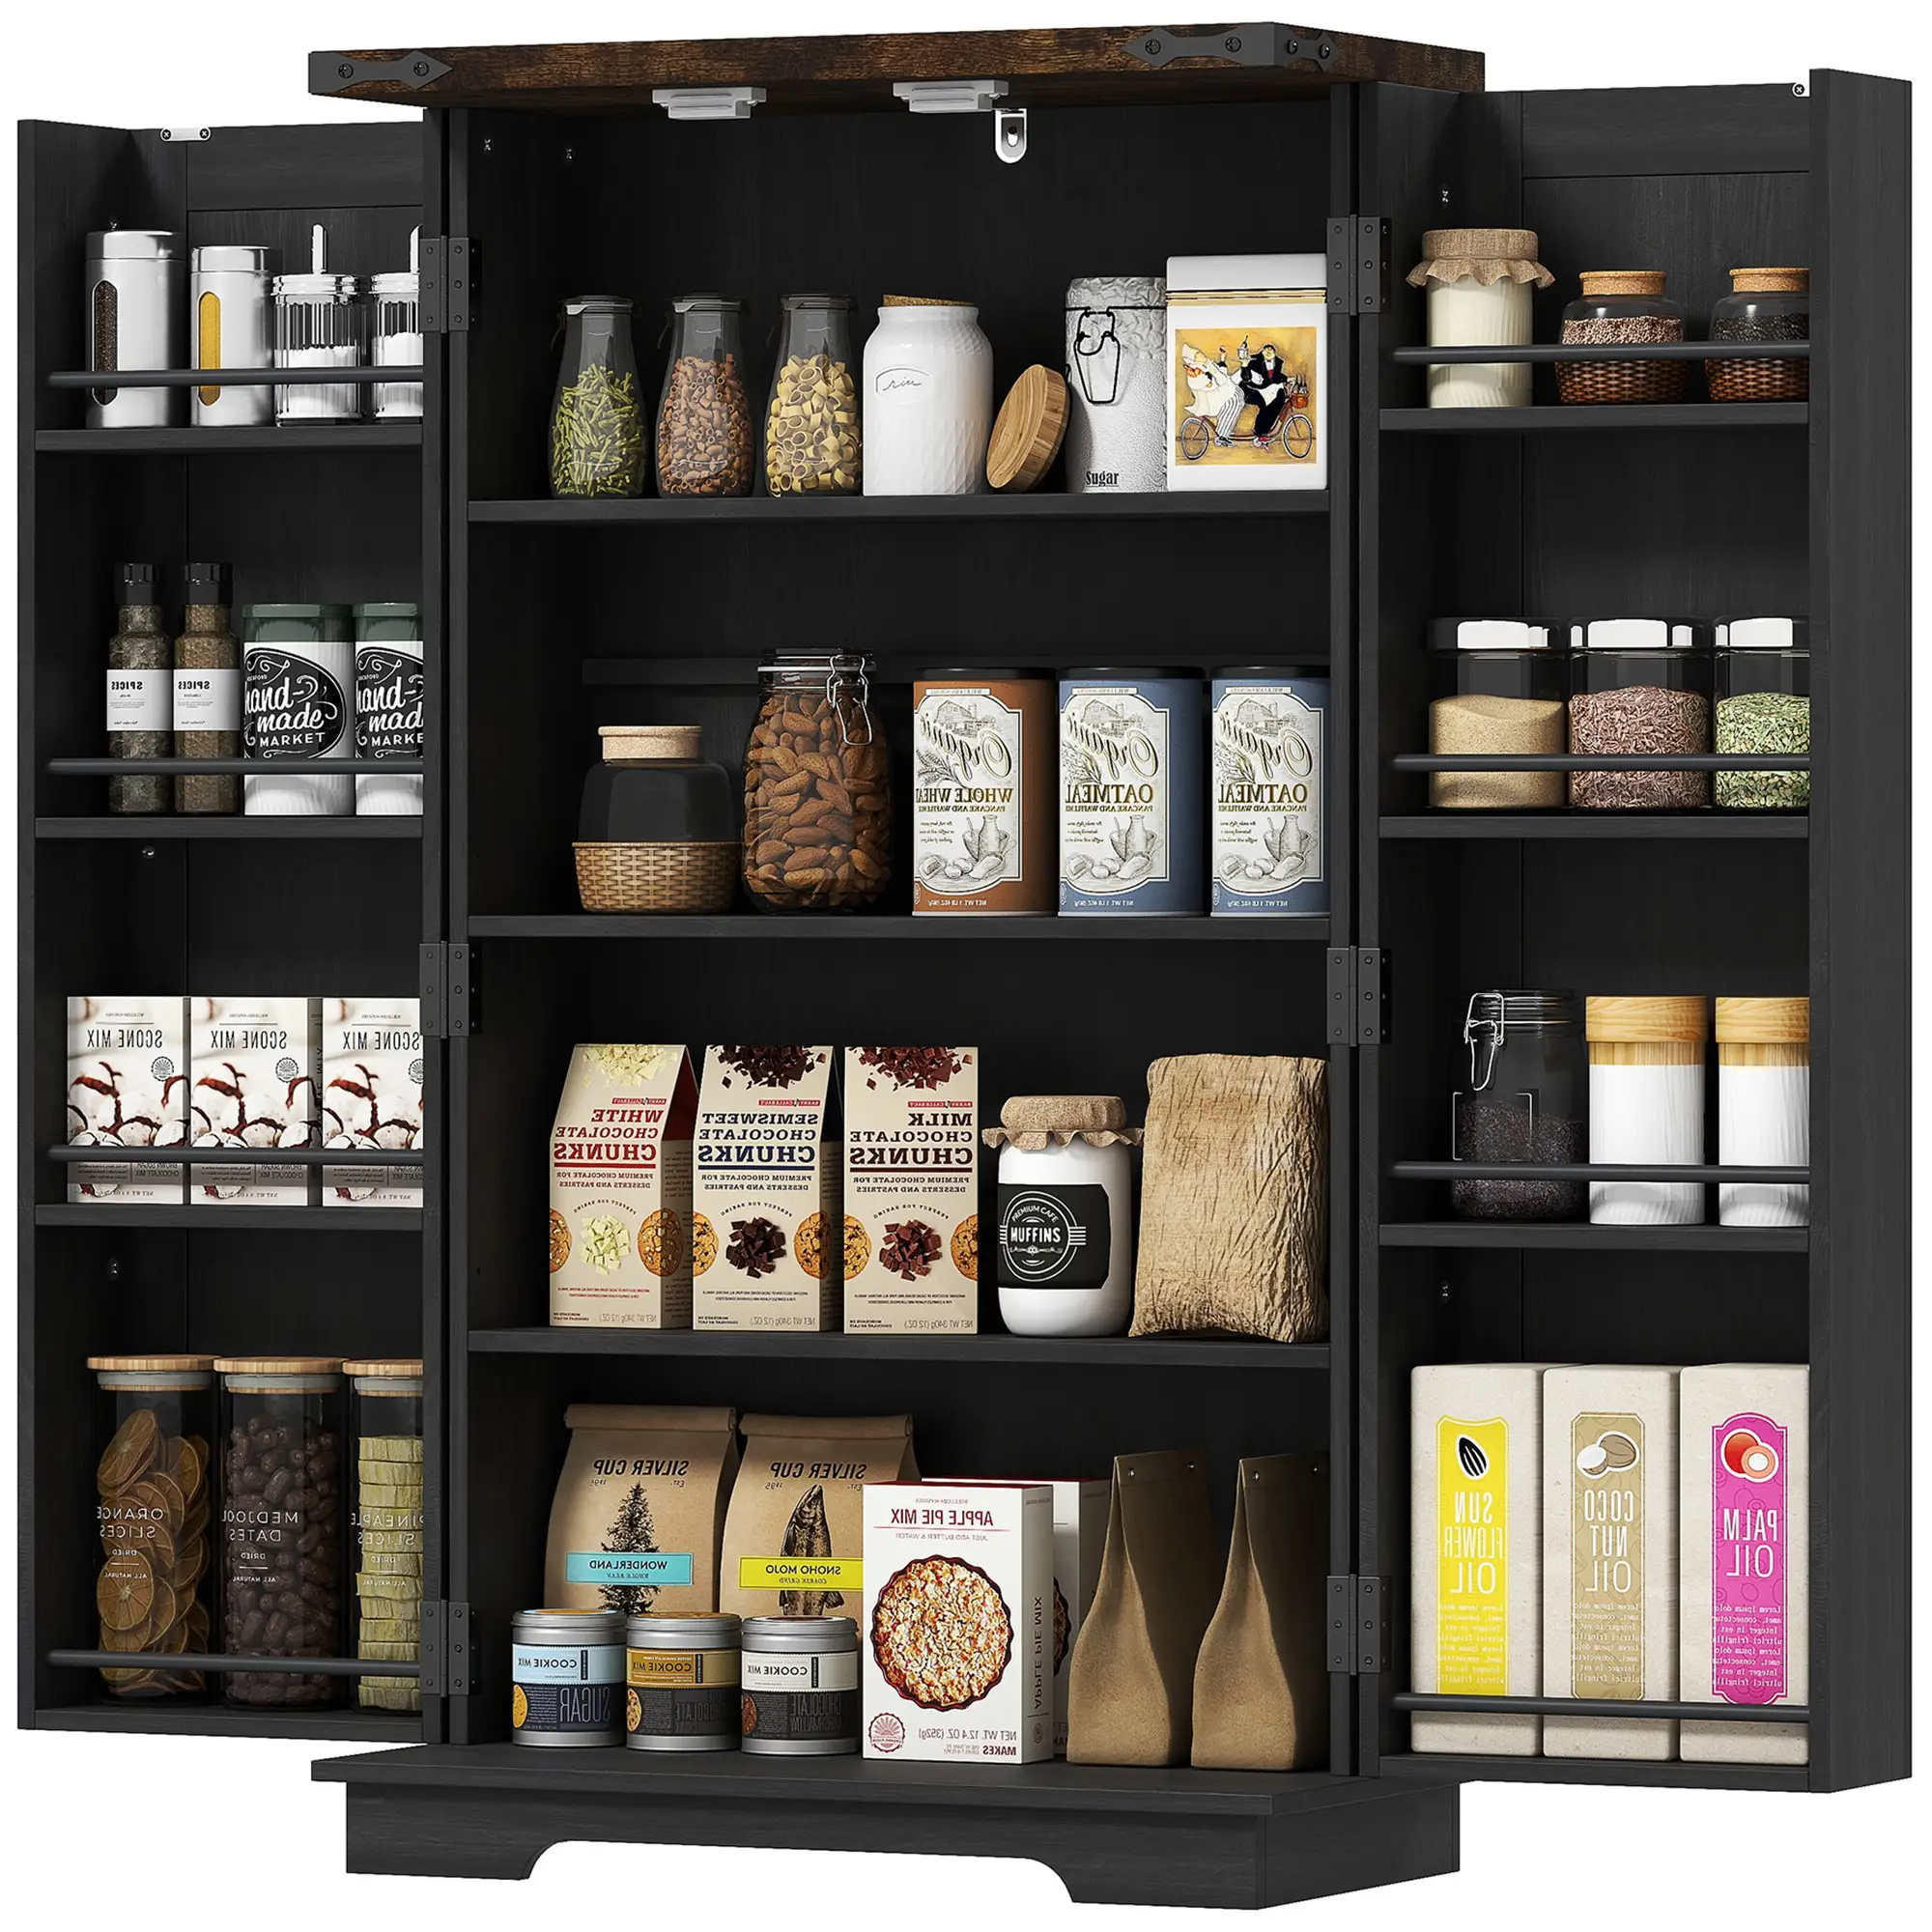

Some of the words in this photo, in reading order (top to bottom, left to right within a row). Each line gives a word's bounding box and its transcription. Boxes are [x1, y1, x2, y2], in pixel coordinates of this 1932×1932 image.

[1086, 470, 1120, 488] Sugar
[257, 701, 324, 732] made
[369, 701, 423, 732] mad
[260, 731, 326, 747] MARKET
[371, 731, 423, 747] MARKE
[1011, 1206, 1040, 1222] PREMIUM
[1040, 1207, 1059, 1223] CAFE
[1010, 1227, 1061, 1243] MUFFINS
